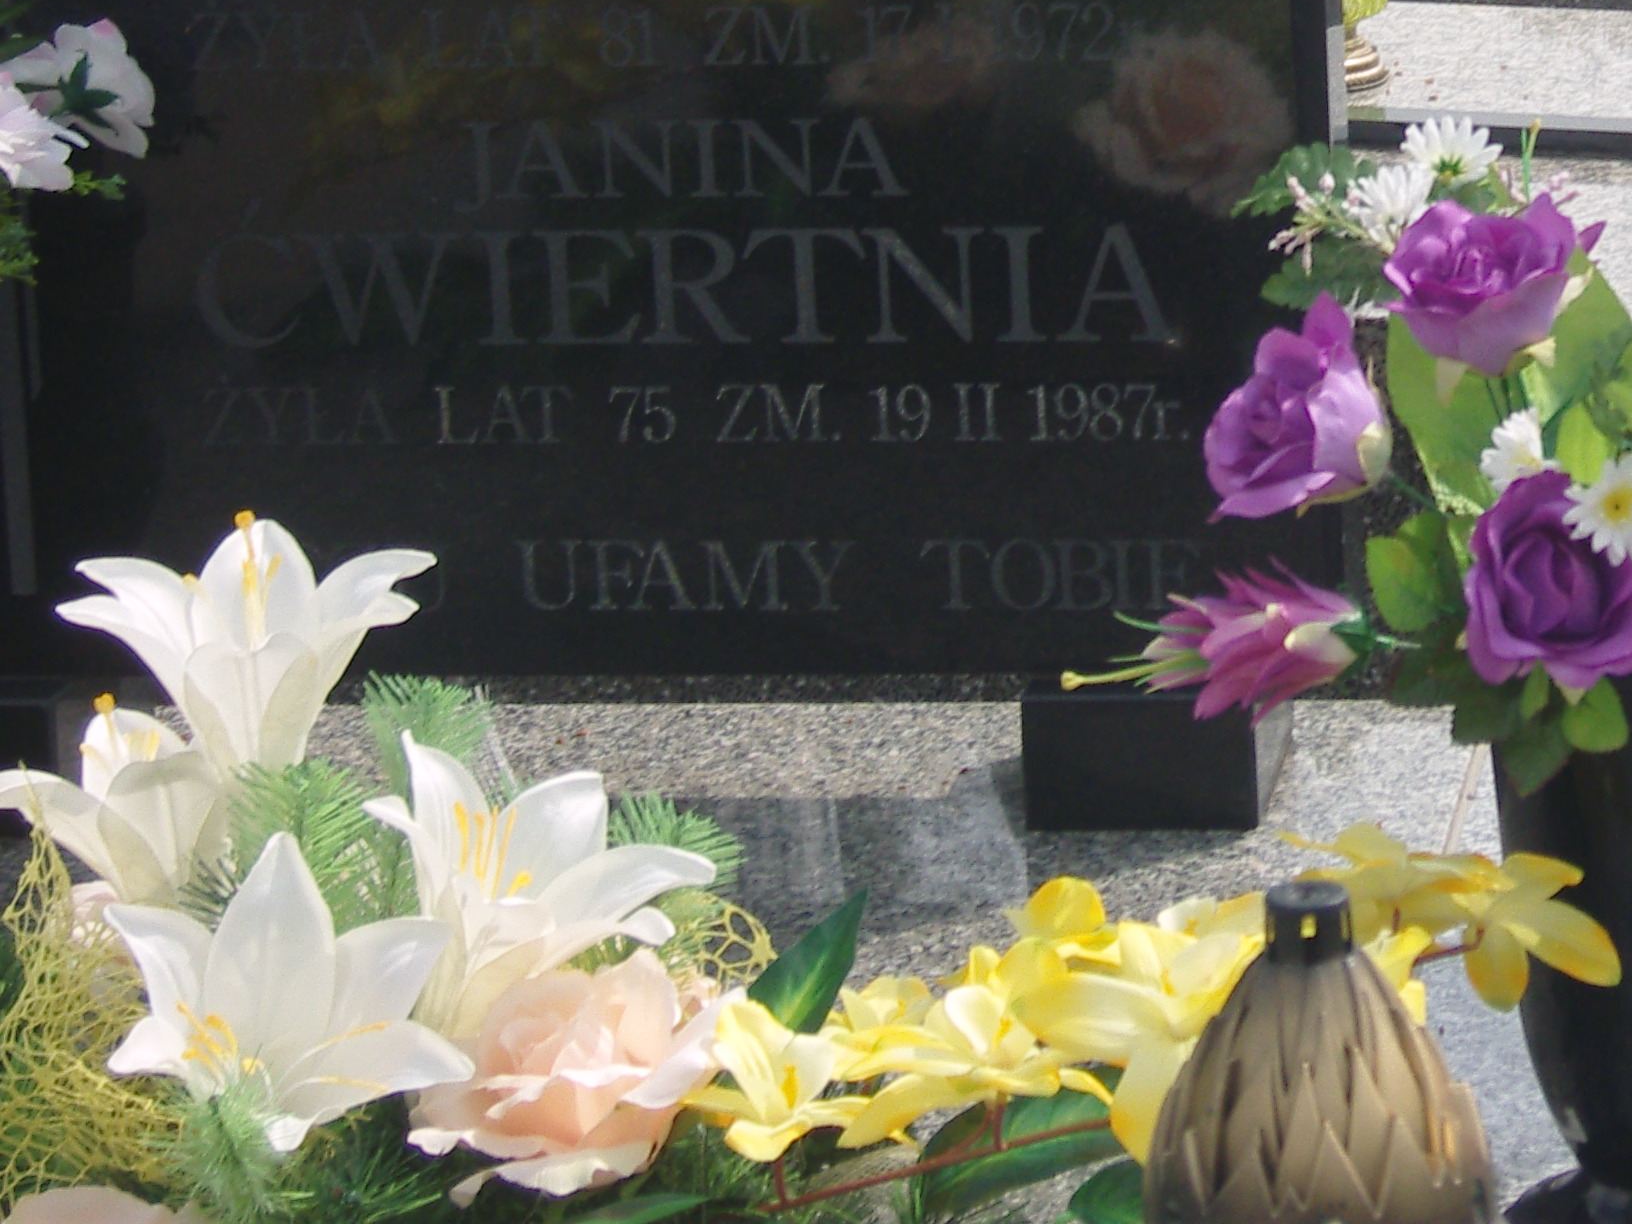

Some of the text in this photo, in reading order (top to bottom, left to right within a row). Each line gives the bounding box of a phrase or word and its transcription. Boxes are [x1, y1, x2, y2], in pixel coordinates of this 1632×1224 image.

[421, 6, 561, 69] LAT
[598, 2, 666, 68] 81
[703, 4, 830, 67] ZM.
[458, 117, 908, 212] JANINA
[194, 196, 1180, 349] ĆWIERTNIA
[203, 375, 1193, 445] ŻYŁA LAT 75 ZM. 19 II 1987r.
[514, 538, 856, 613] UFAMY
